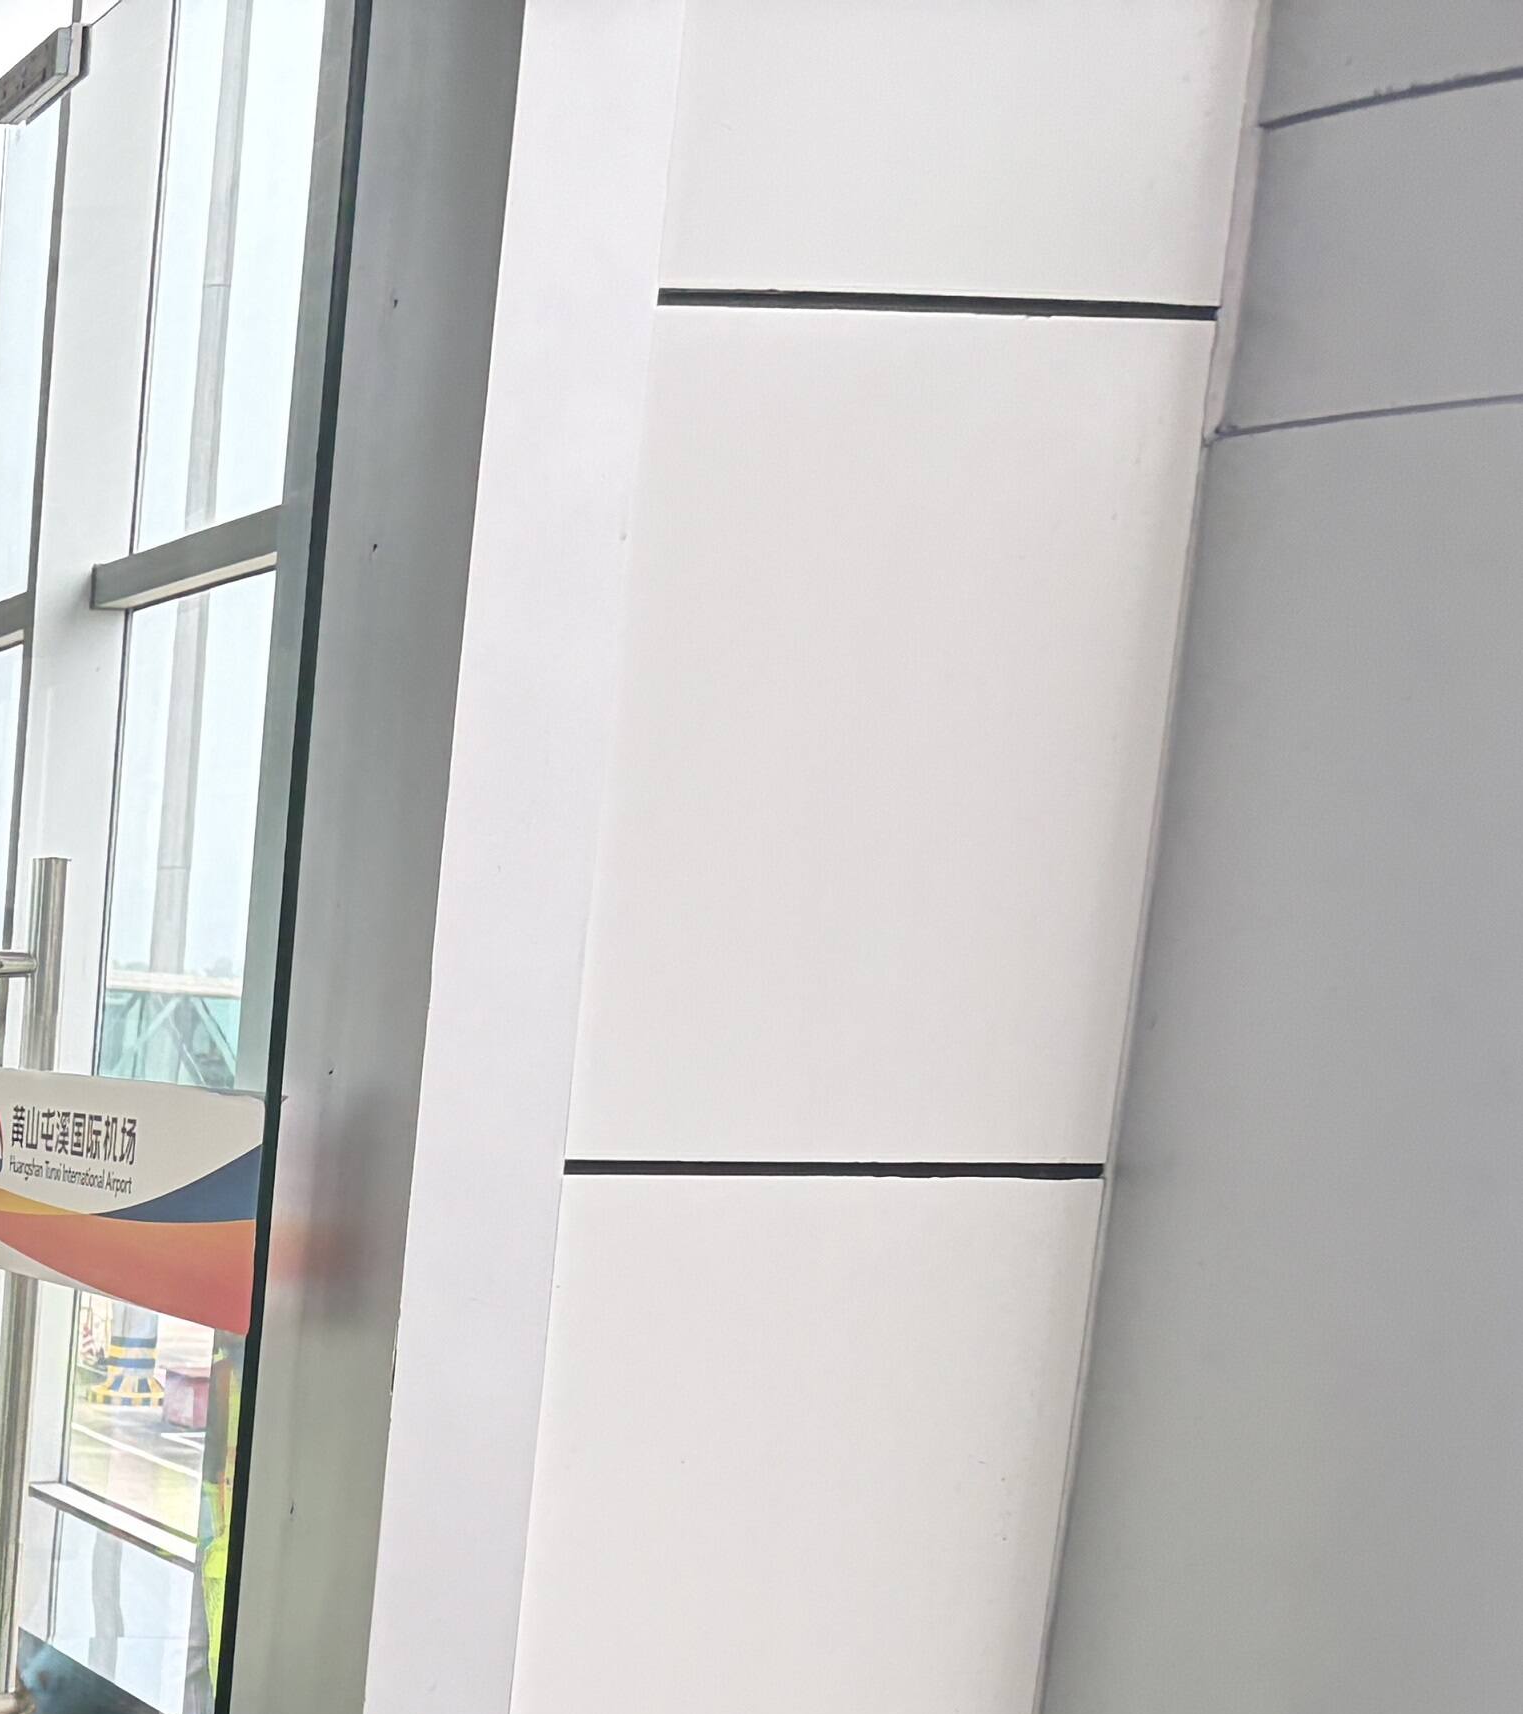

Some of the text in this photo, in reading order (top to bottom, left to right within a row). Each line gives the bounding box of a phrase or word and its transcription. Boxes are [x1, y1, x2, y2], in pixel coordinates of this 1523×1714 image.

[11, 1105, 137, 1166] 黄山屯溪国际机场
[9, 1155, 43, 1181] Huangshan
[63, 1163, 105, 1189] International
[105, 1171, 132, 1198] Airport
